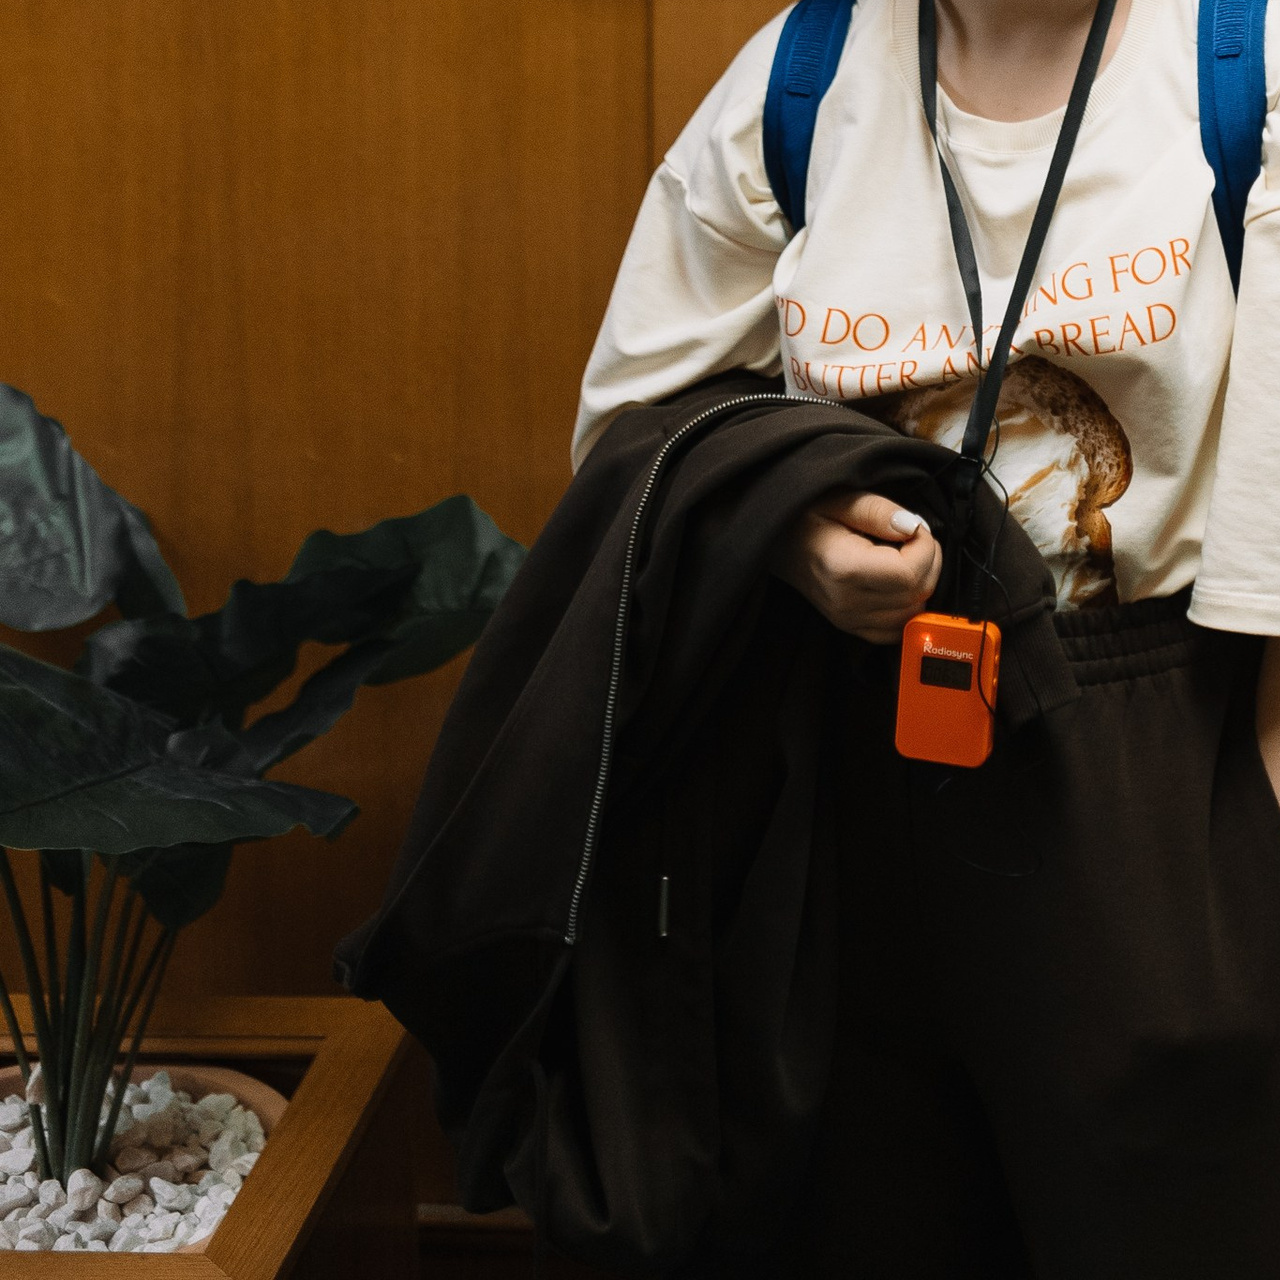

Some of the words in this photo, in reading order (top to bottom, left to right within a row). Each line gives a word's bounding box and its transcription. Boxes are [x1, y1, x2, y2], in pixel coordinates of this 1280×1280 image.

[819, 307, 891, 352] DO
[1108, 237, 1192, 294] FOR
[790, 356, 921, 399] BUTTER
[941, 342, 1025, 382] AN
[1034, 303, 1177, 357] BREAD
[923, 641, 974, 660] Radiosync
